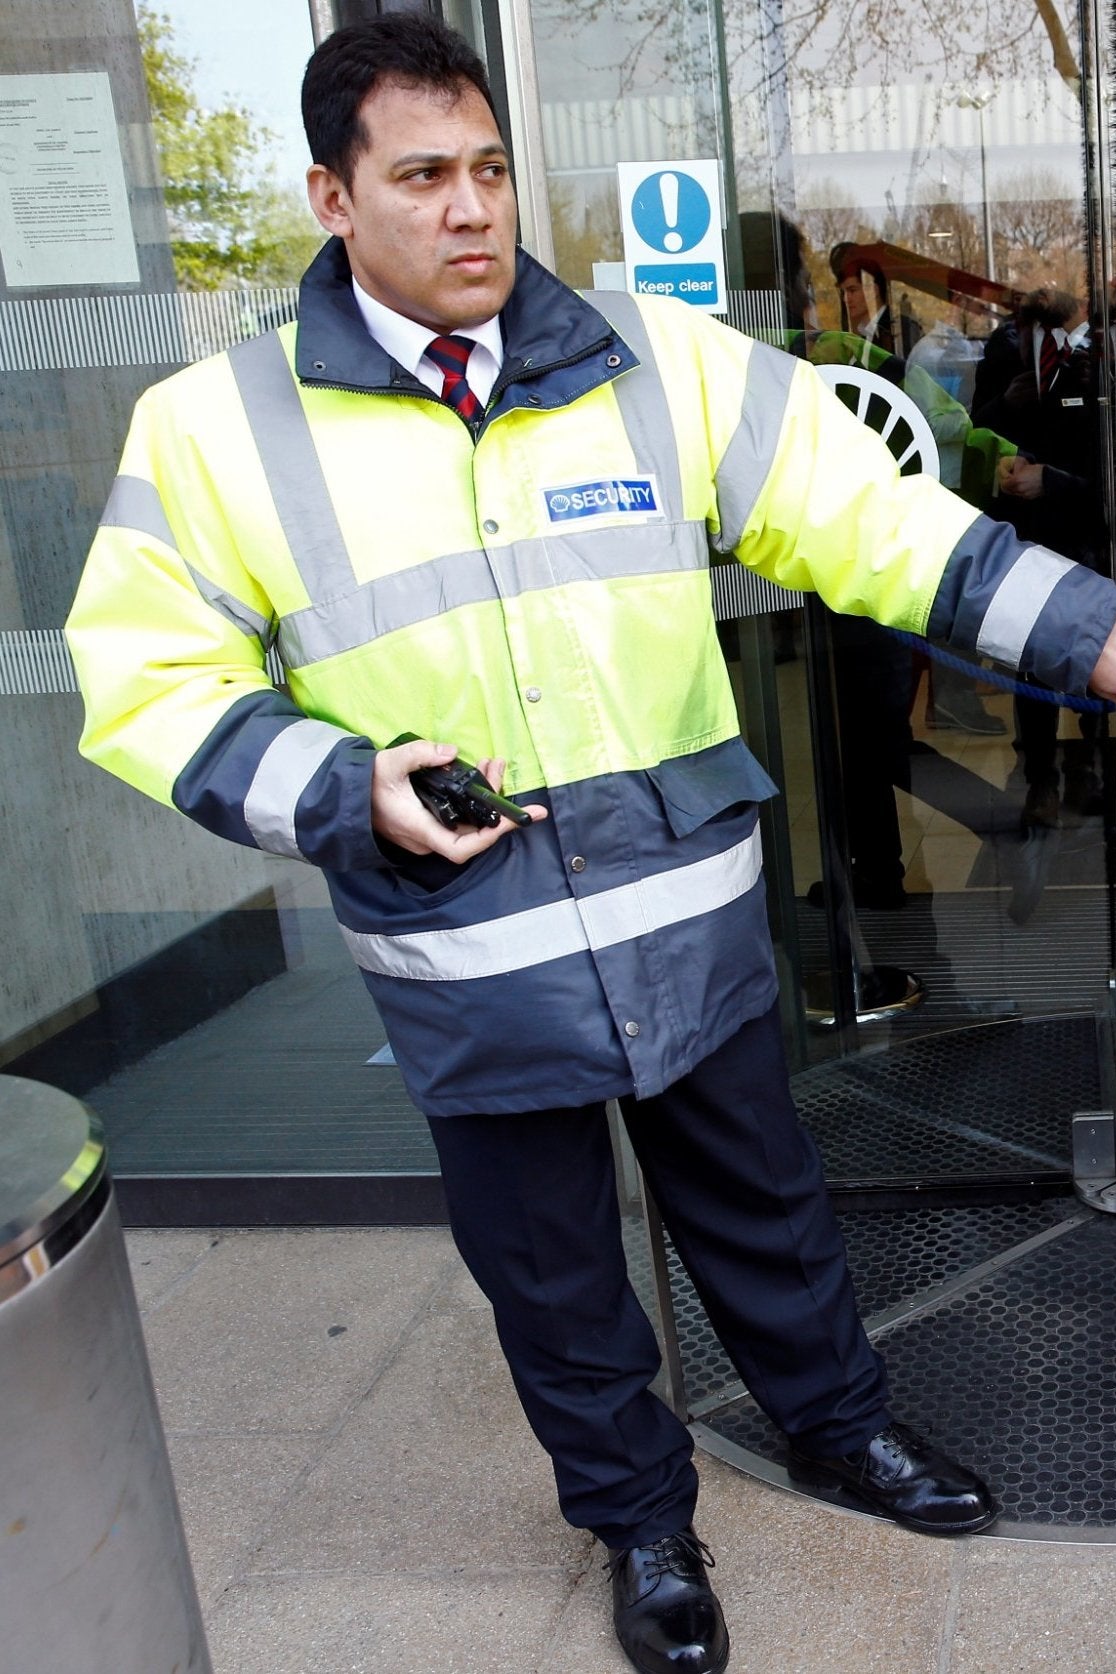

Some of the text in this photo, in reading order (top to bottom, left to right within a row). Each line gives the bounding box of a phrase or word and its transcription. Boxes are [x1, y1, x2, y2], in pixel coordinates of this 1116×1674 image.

[638, 279, 714, 295] Keep clear
[571, 487, 650, 510] SECURITY
